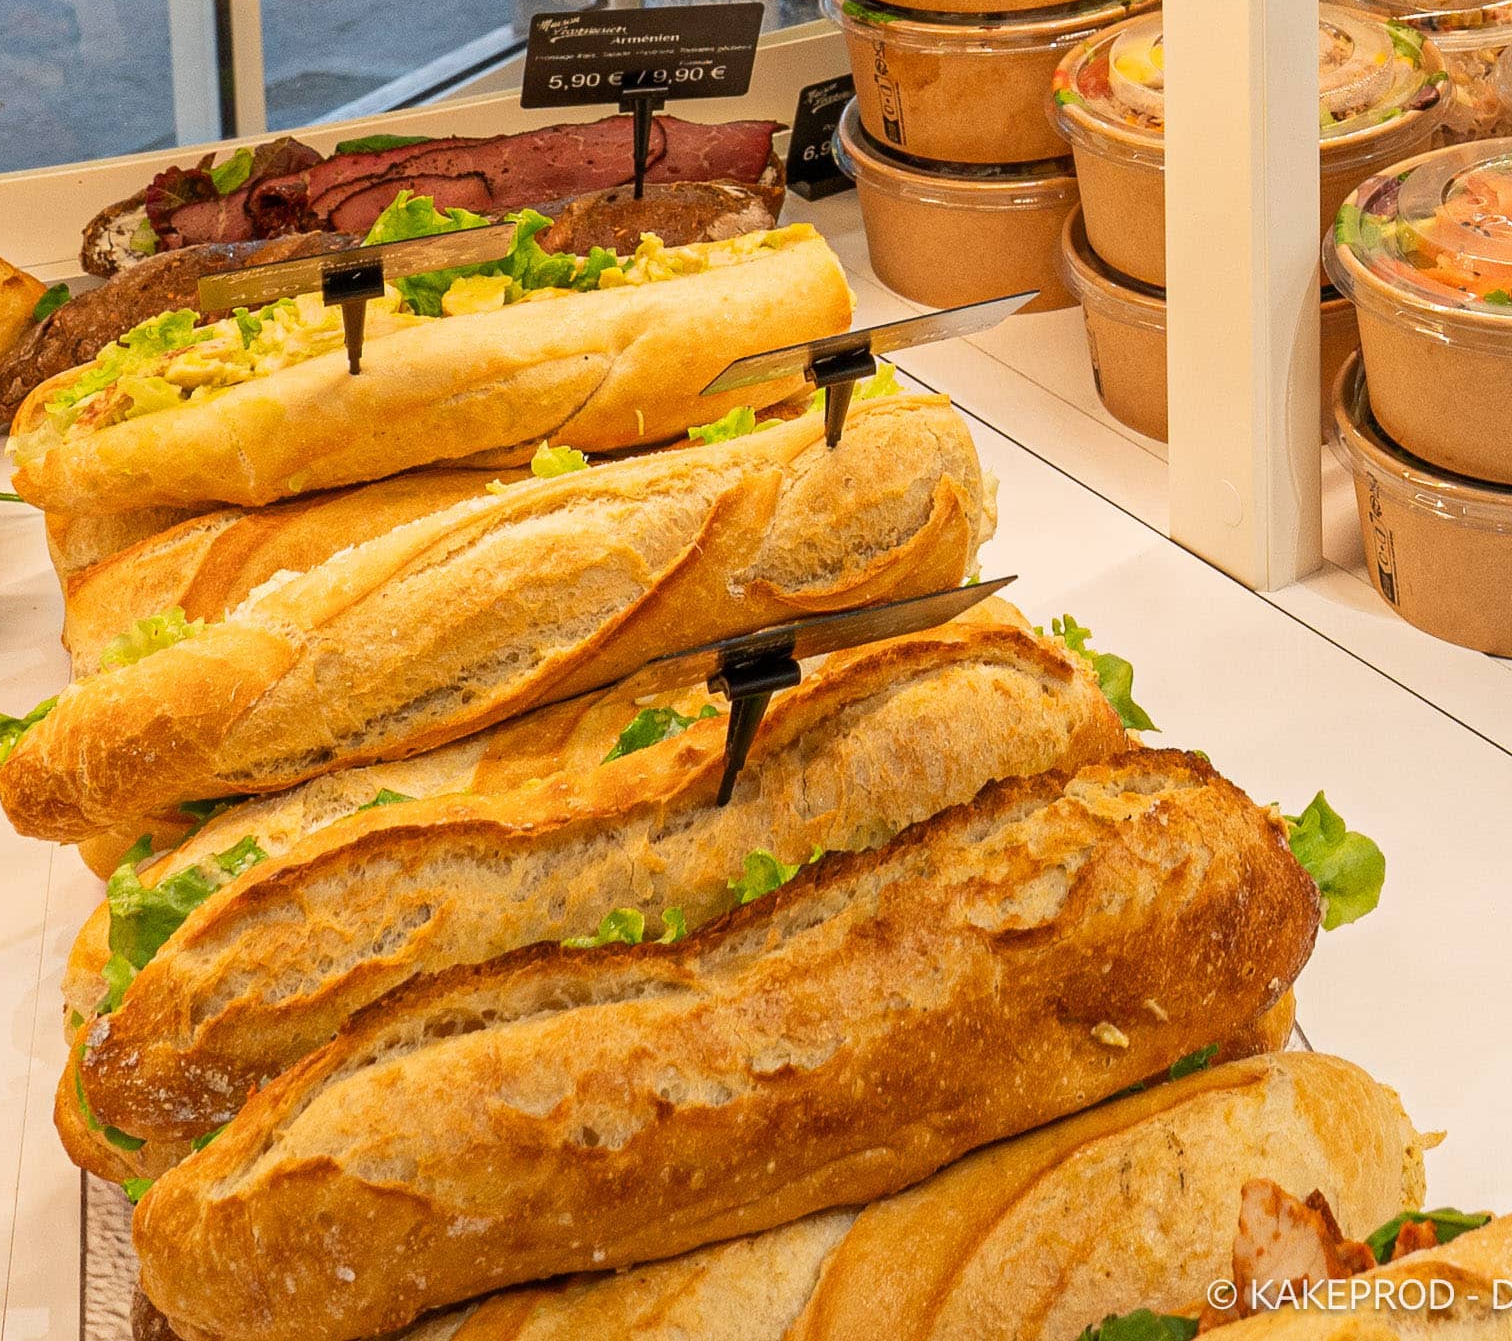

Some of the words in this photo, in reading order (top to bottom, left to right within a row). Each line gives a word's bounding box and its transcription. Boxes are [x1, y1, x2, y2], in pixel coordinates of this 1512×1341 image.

[610, 33, 680, 46] Arménien
[548, 73, 601, 91] 5,90
[608, 71, 625, 86] €
[653, 67, 704, 85] 9,90
[711, 65, 727, 80] €
[803, 140, 831, 161] 6,9
